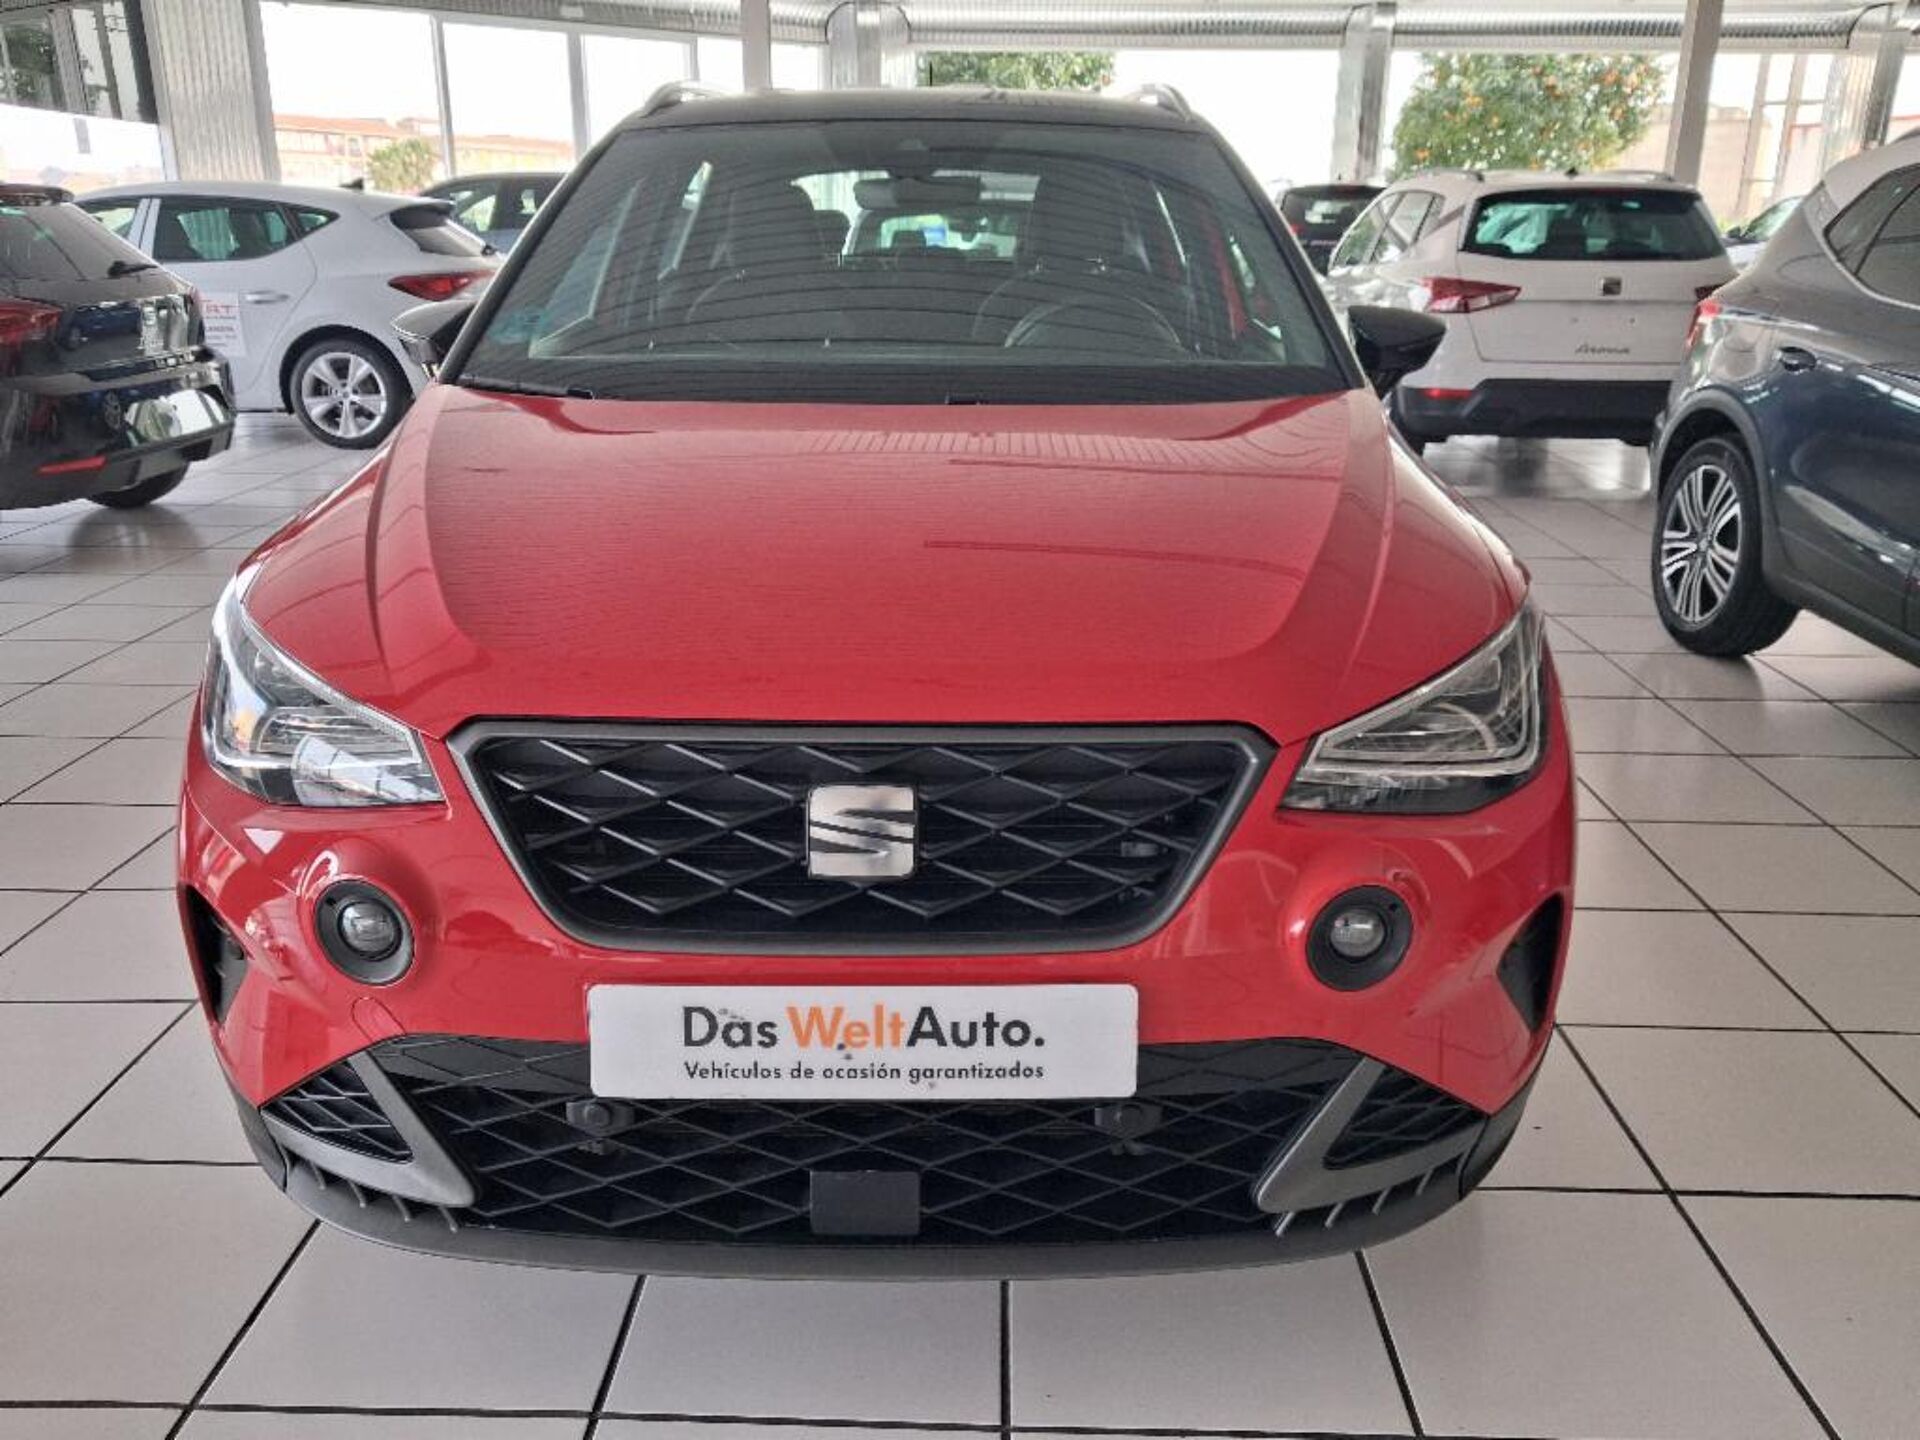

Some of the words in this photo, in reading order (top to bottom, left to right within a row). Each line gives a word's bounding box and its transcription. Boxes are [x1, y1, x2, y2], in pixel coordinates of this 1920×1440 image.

[682, 1006, 778, 1048] Das
[684, 1059, 781, 1079] Vehículos
[789, 1060, 815, 1079] de
[822, 1058, 900, 1079] ocasión
[908, 1059, 1044, 1084] garantizados
